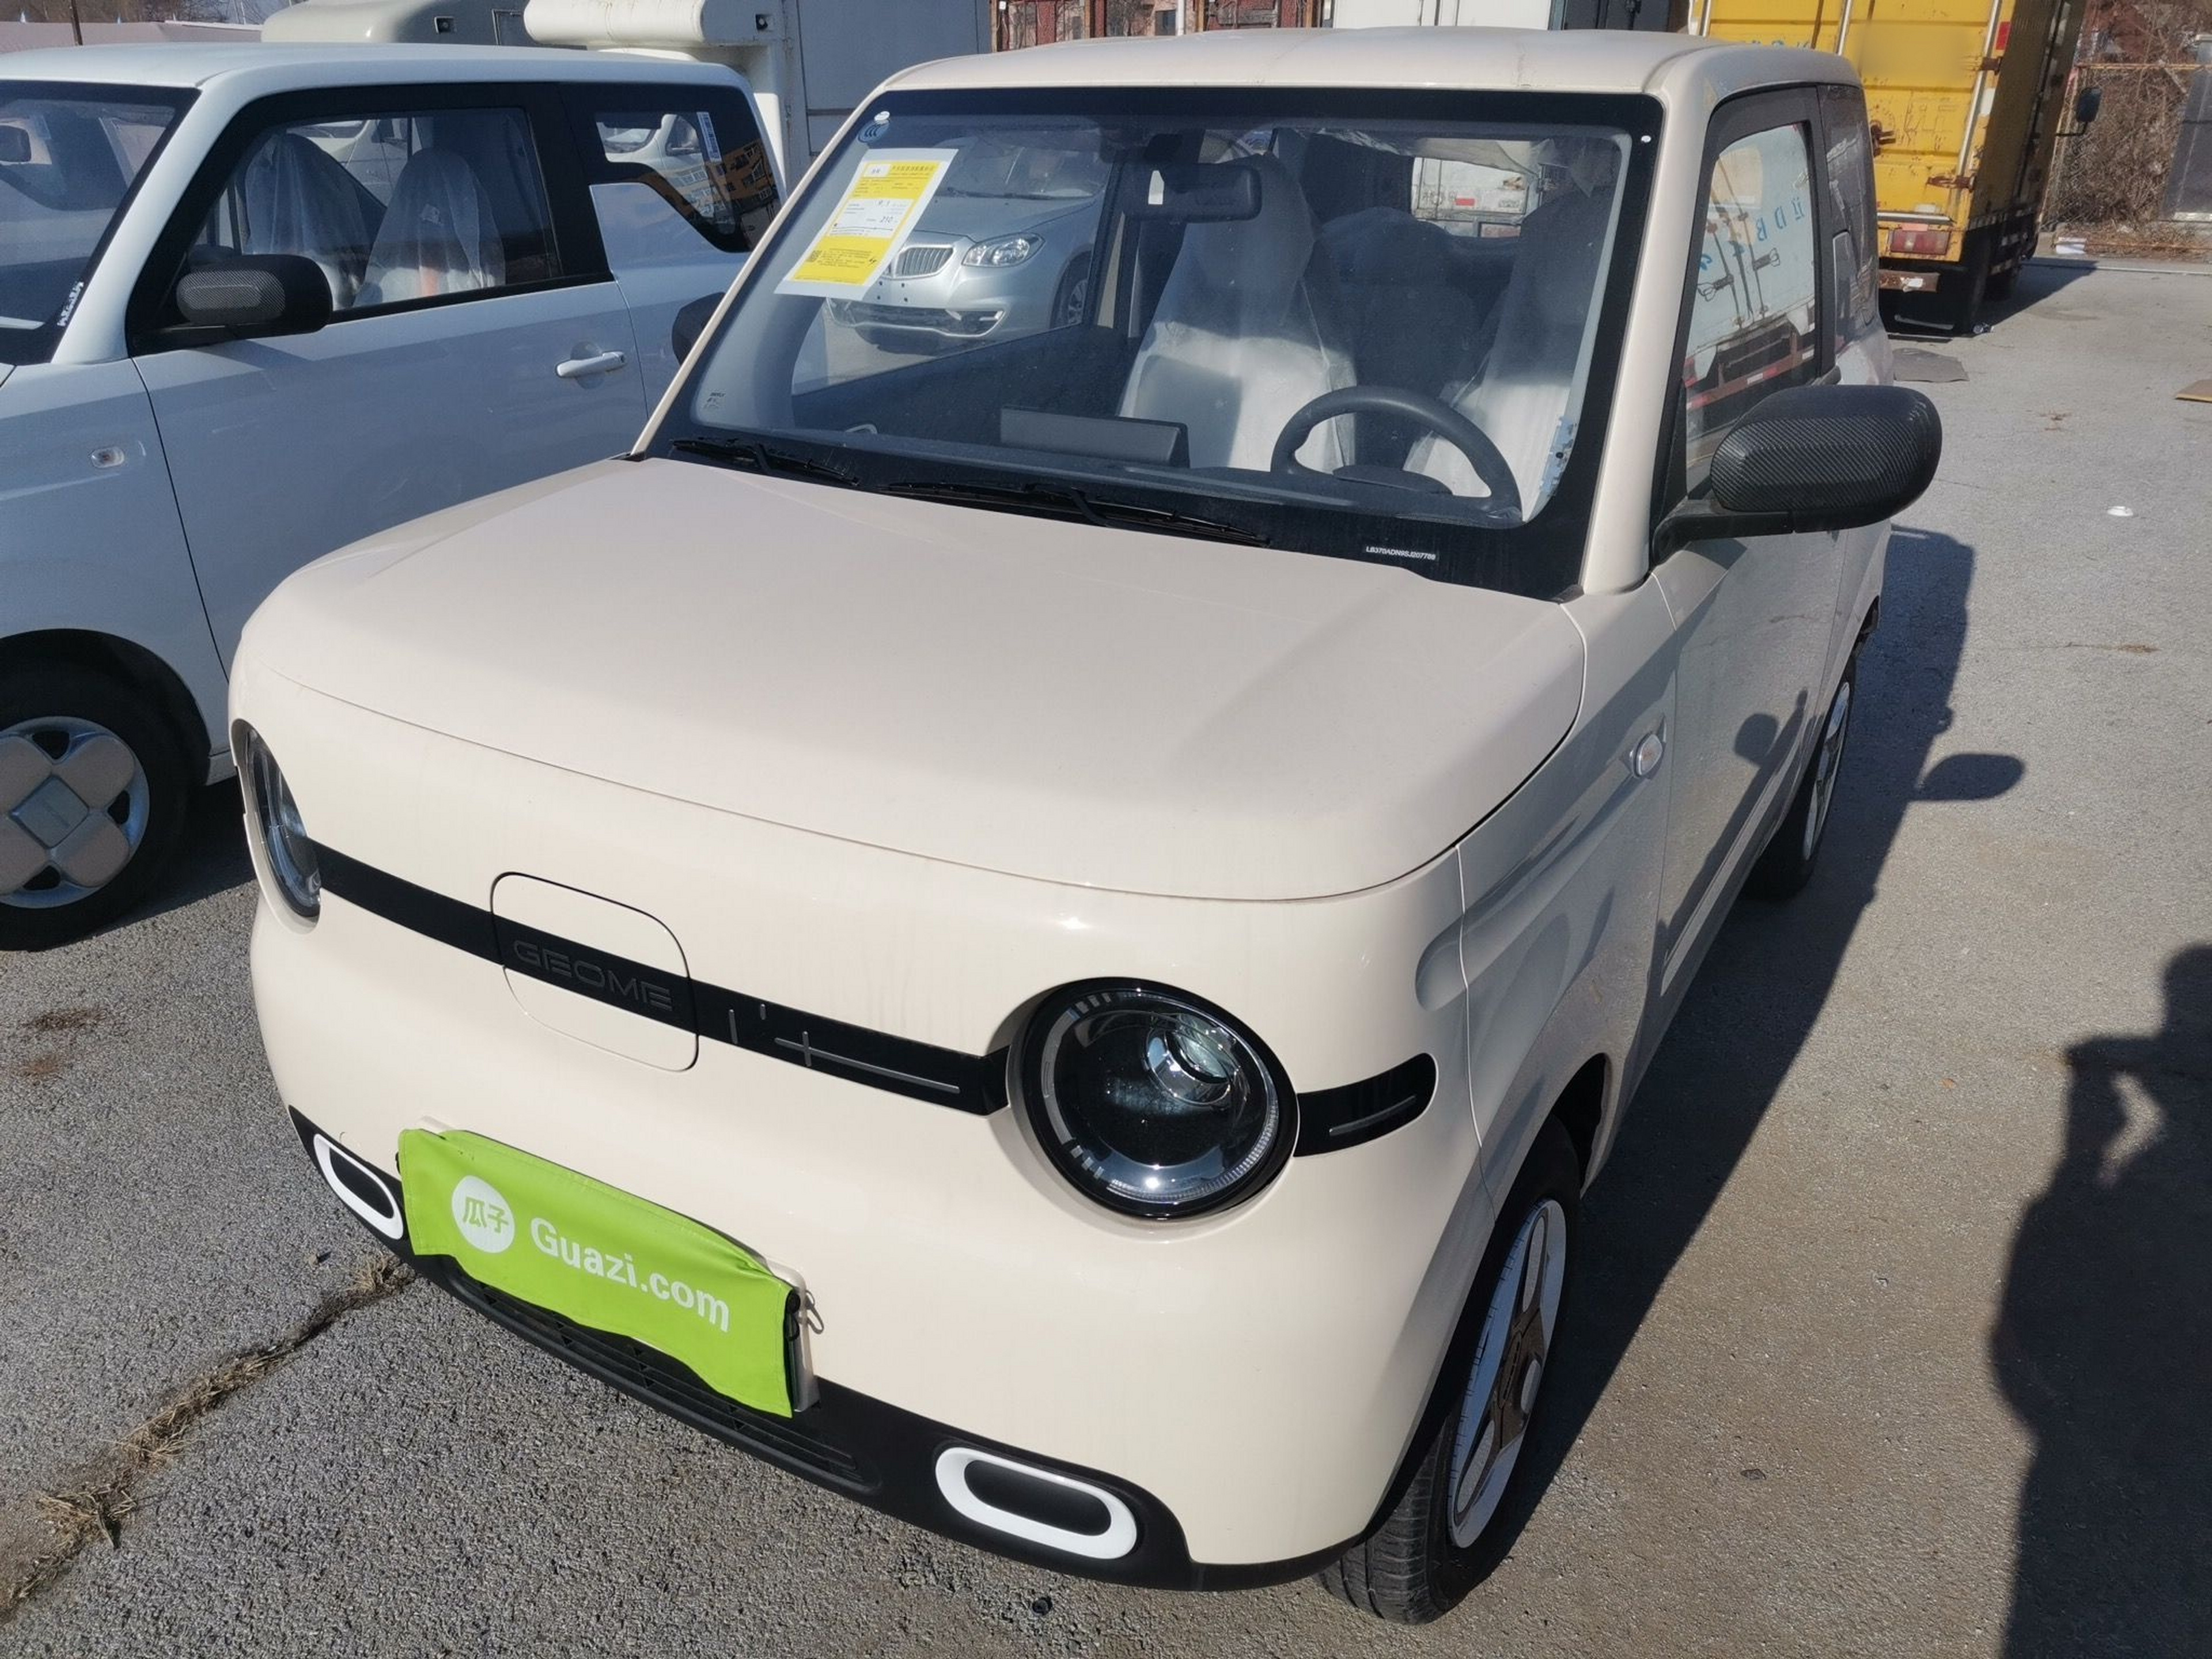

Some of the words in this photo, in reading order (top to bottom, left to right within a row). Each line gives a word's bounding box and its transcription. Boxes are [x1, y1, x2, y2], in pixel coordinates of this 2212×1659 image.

[513, 940, 673, 1012] GEOME
[461, 1195, 509, 1234] 瓜子
[530, 1217, 730, 1332] Guazi.com
